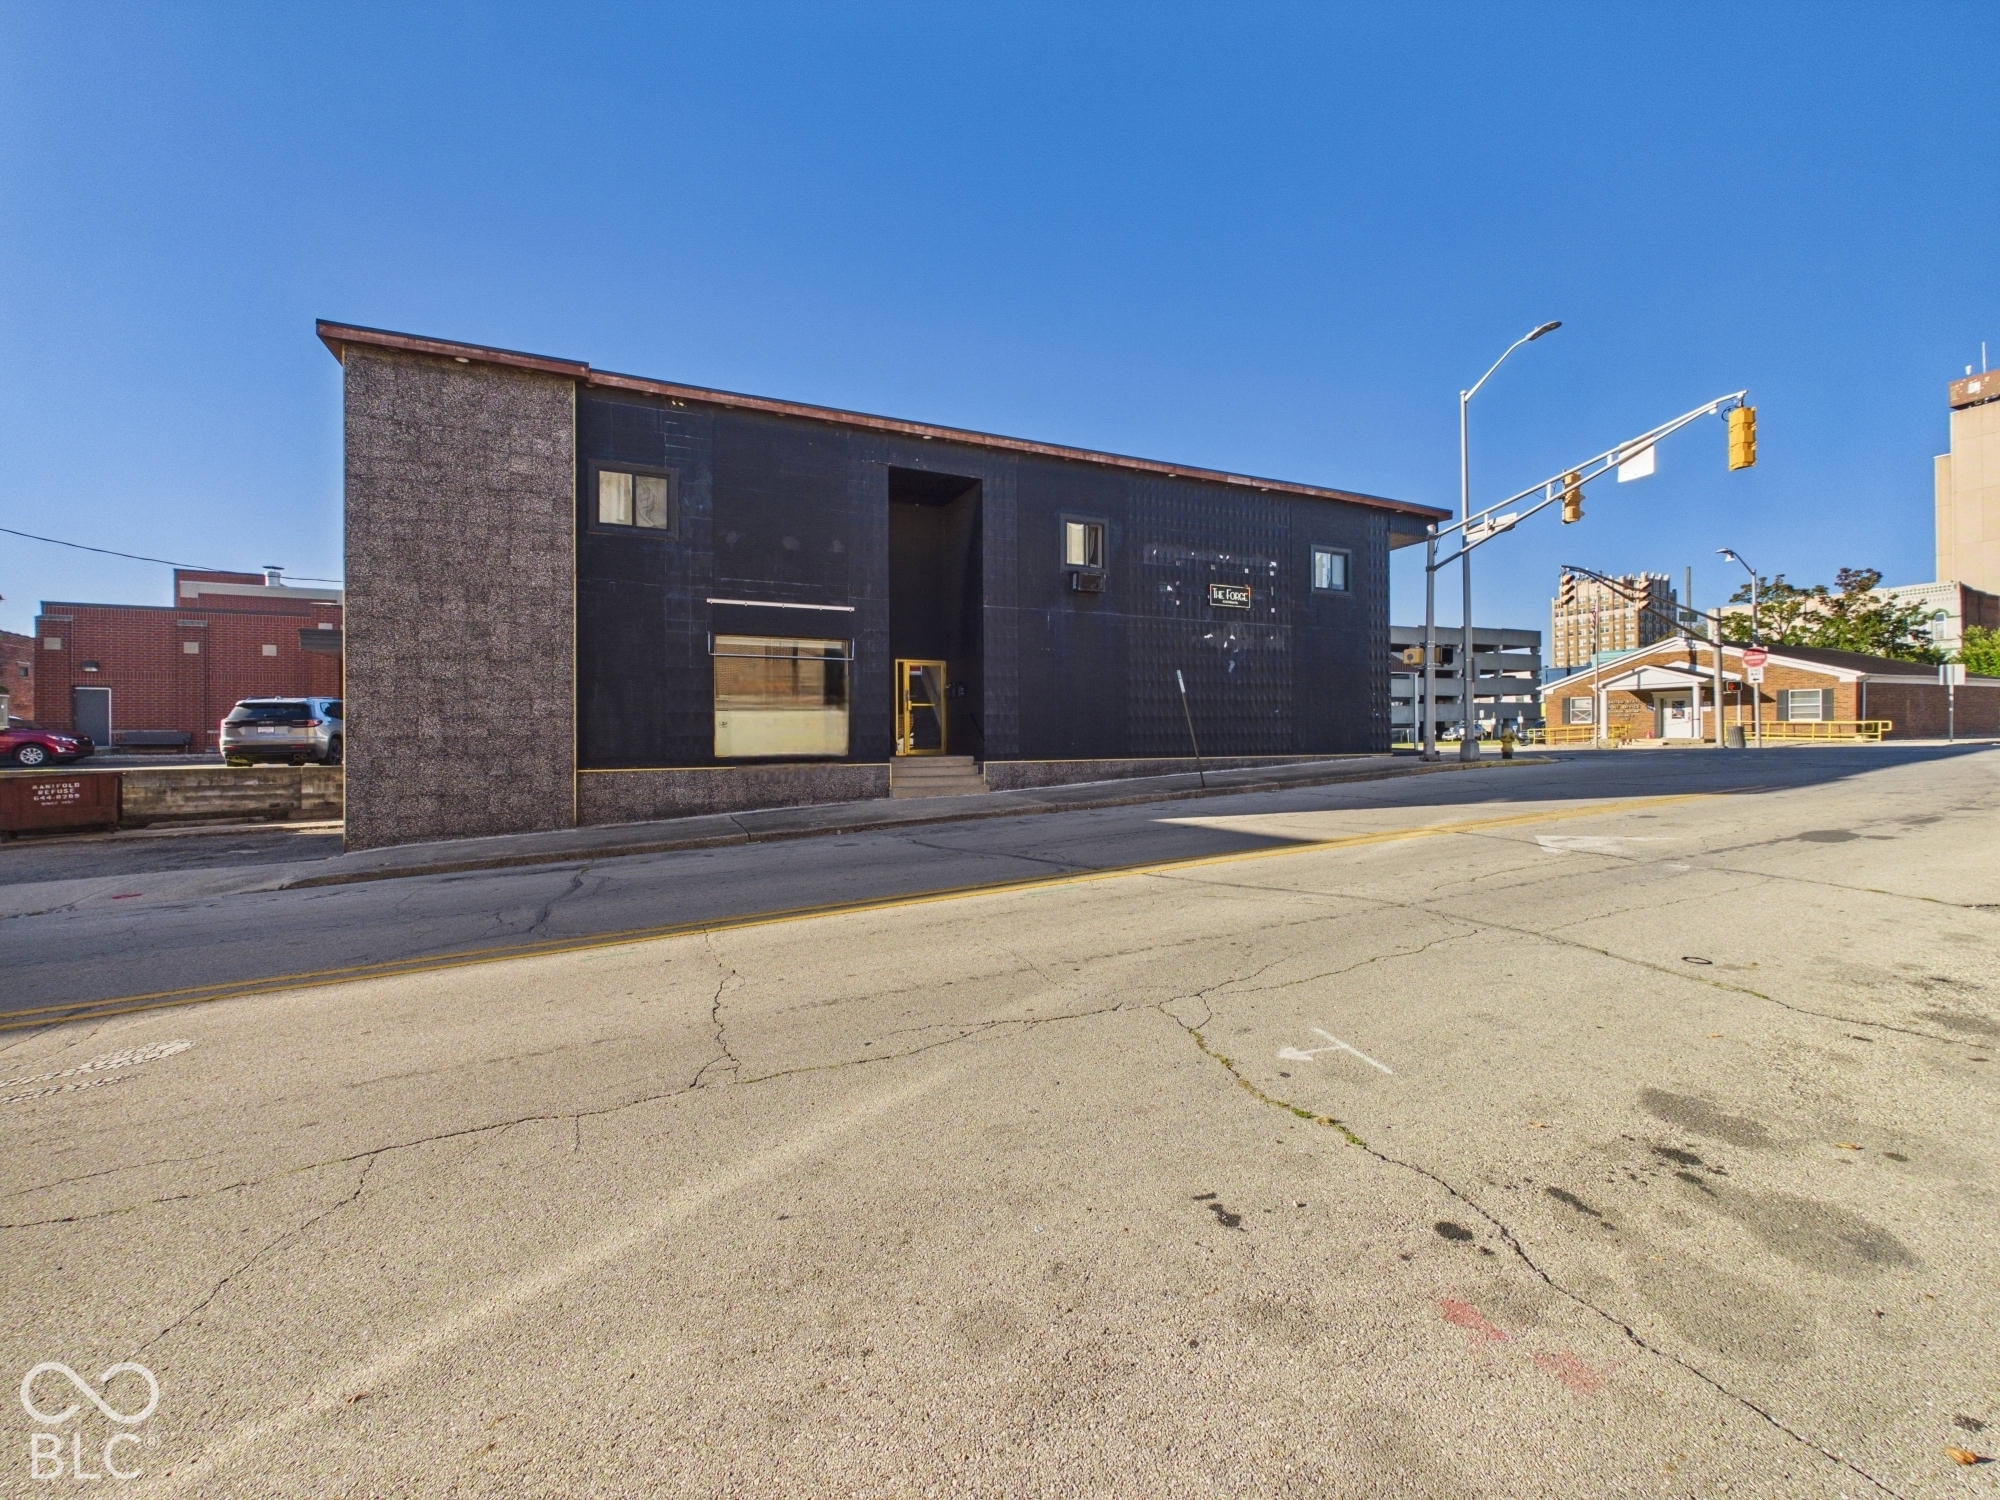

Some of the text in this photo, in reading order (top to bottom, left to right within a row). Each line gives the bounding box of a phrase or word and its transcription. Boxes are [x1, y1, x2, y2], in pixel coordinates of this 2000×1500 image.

[1212, 588, 1248, 601] THE FORGE
[32, 782, 80, 790] MANIFOLD
